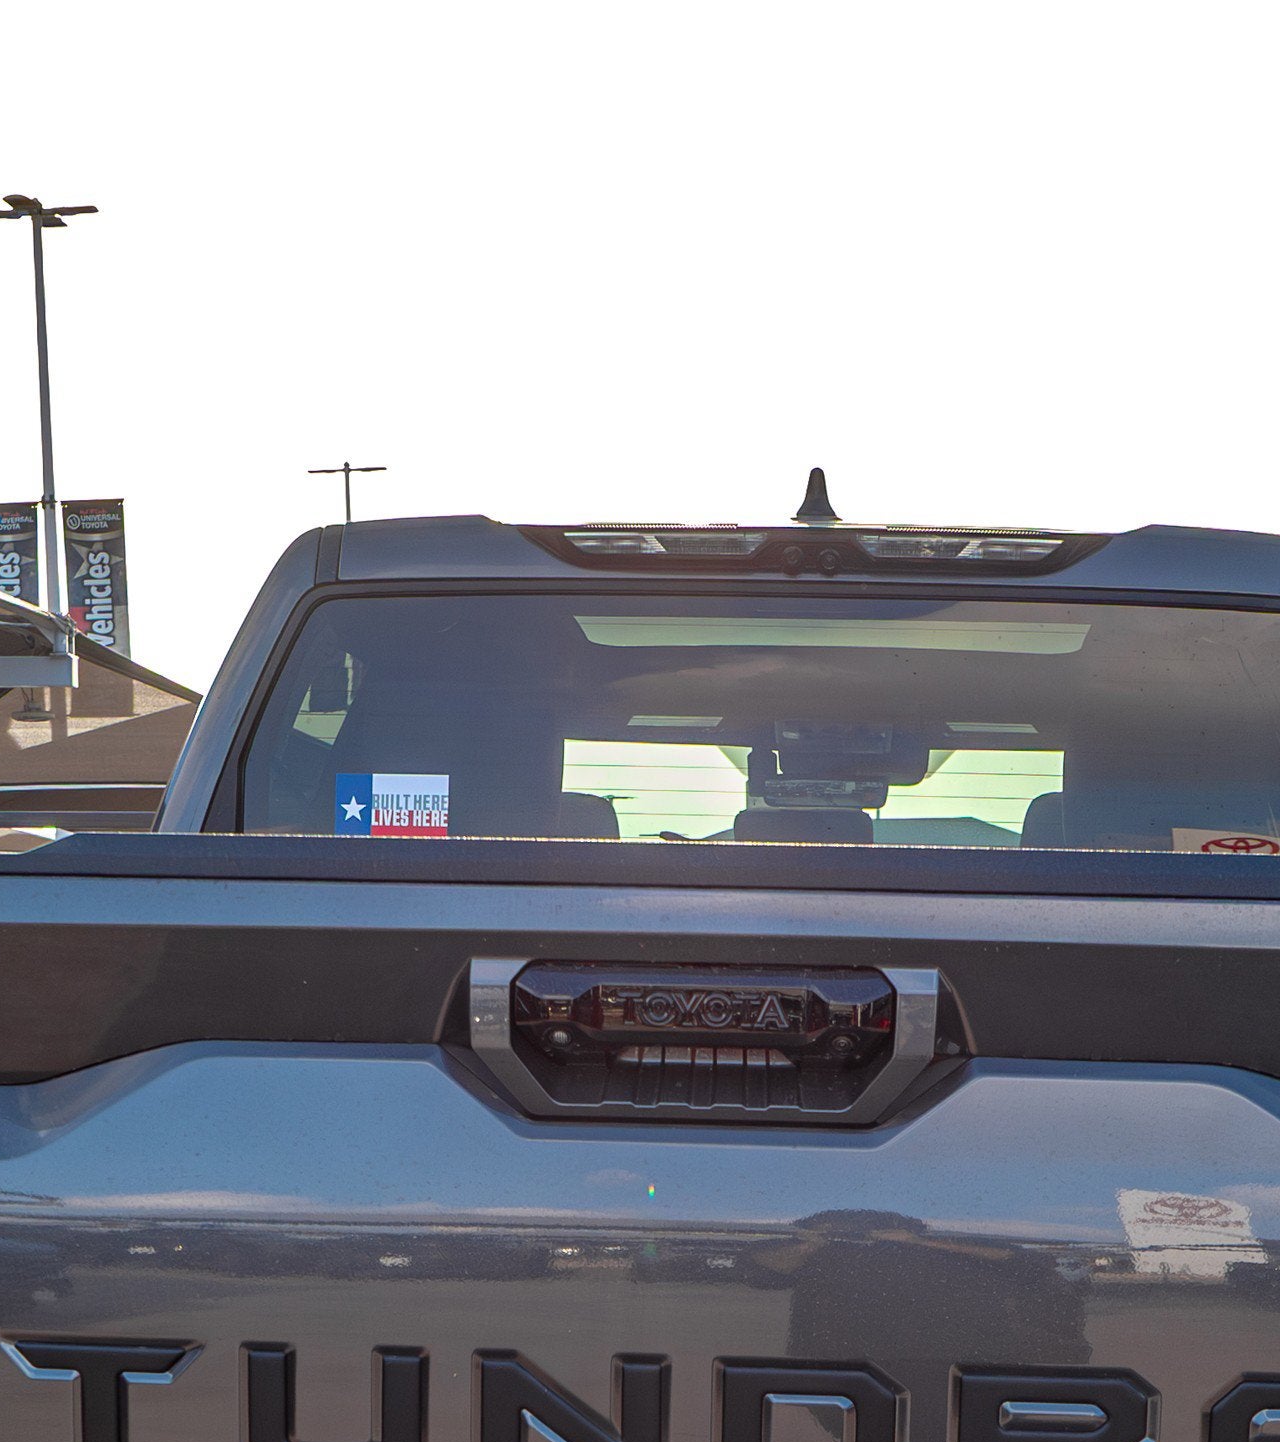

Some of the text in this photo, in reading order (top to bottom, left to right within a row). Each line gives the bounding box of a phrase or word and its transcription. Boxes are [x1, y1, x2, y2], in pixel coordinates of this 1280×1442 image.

[80, 514, 120, 522] UNIVERSAL
[80, 521, 109, 529] TOYOTA
[372, 793, 449, 811] BUILT HERE
[371, 809, 448, 827] LIVES HERE
[617, 990, 790, 1029] TOYOTA
